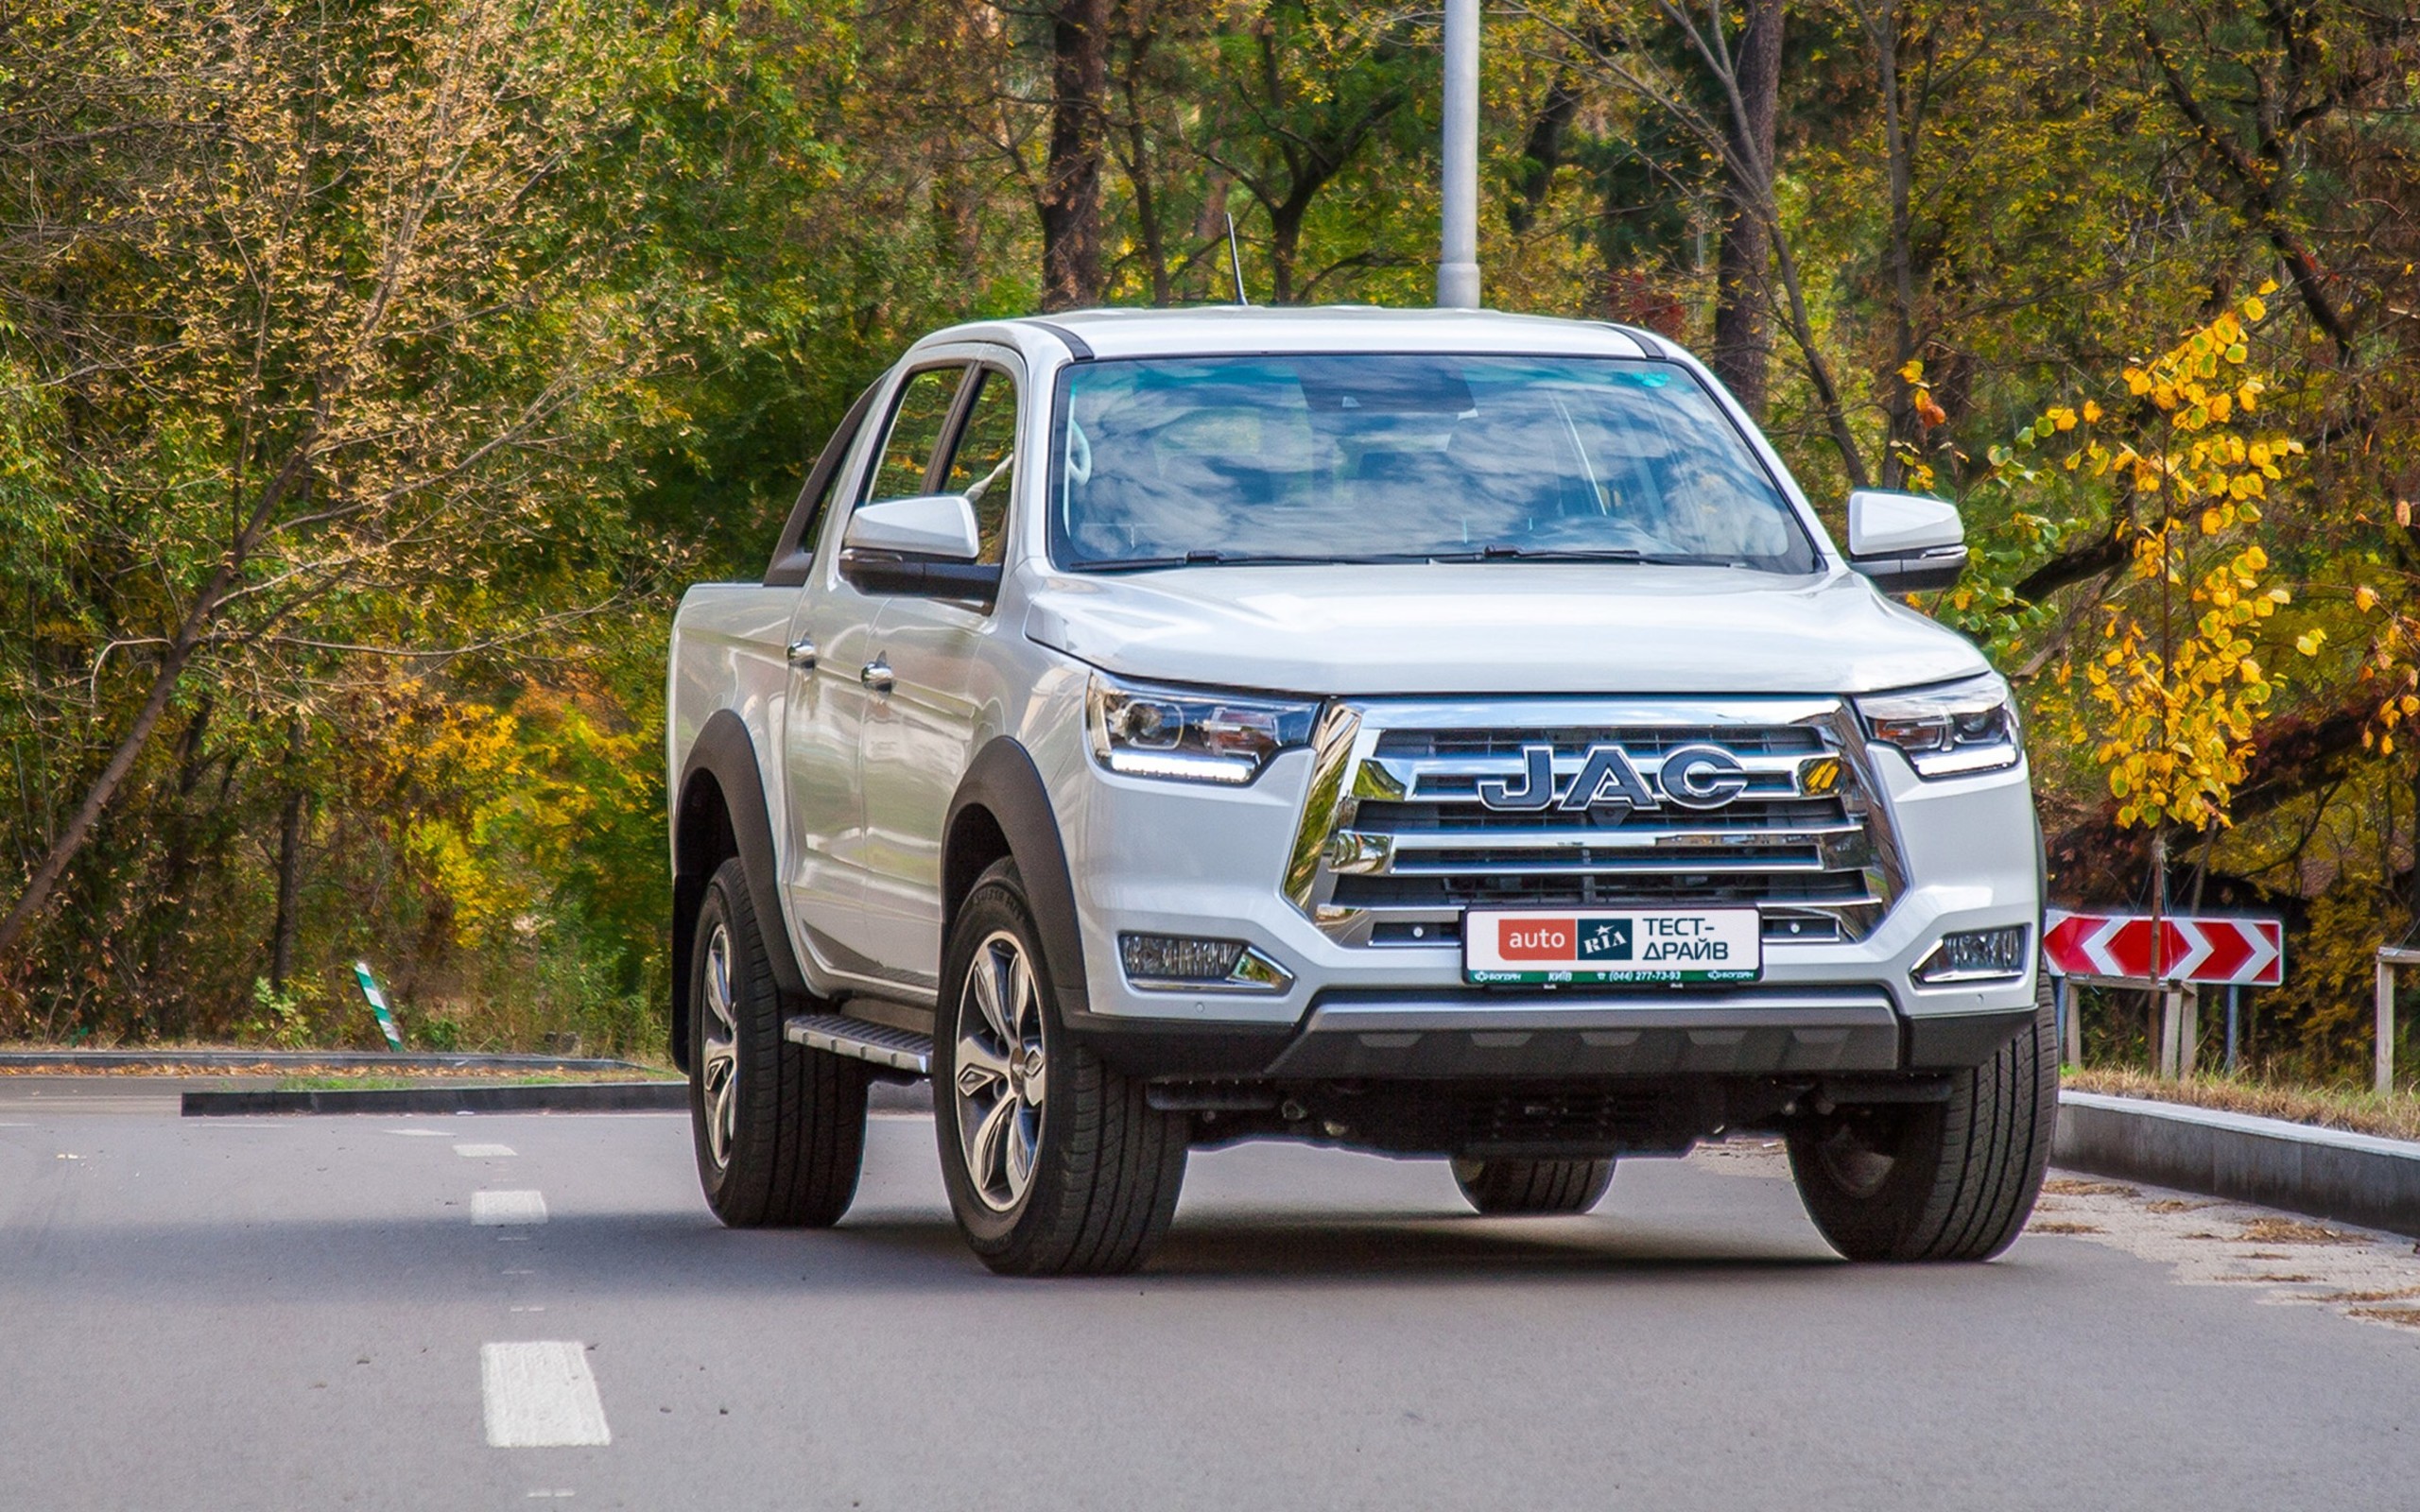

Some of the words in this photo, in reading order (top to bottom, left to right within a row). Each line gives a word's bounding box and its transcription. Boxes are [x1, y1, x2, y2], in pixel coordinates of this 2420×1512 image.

[1478, 745, 1749, 811] JAC
[1642, 918, 1715, 936] ТЕСТ-
[1509, 928, 1565, 949] auto
[1582, 930, 1628, 954] RIA
[1642, 937, 1729, 961] ДРАЙВ
[1609, 971, 1634, 982] (044)
[1635, 971, 1682, 981] 277-73-93
